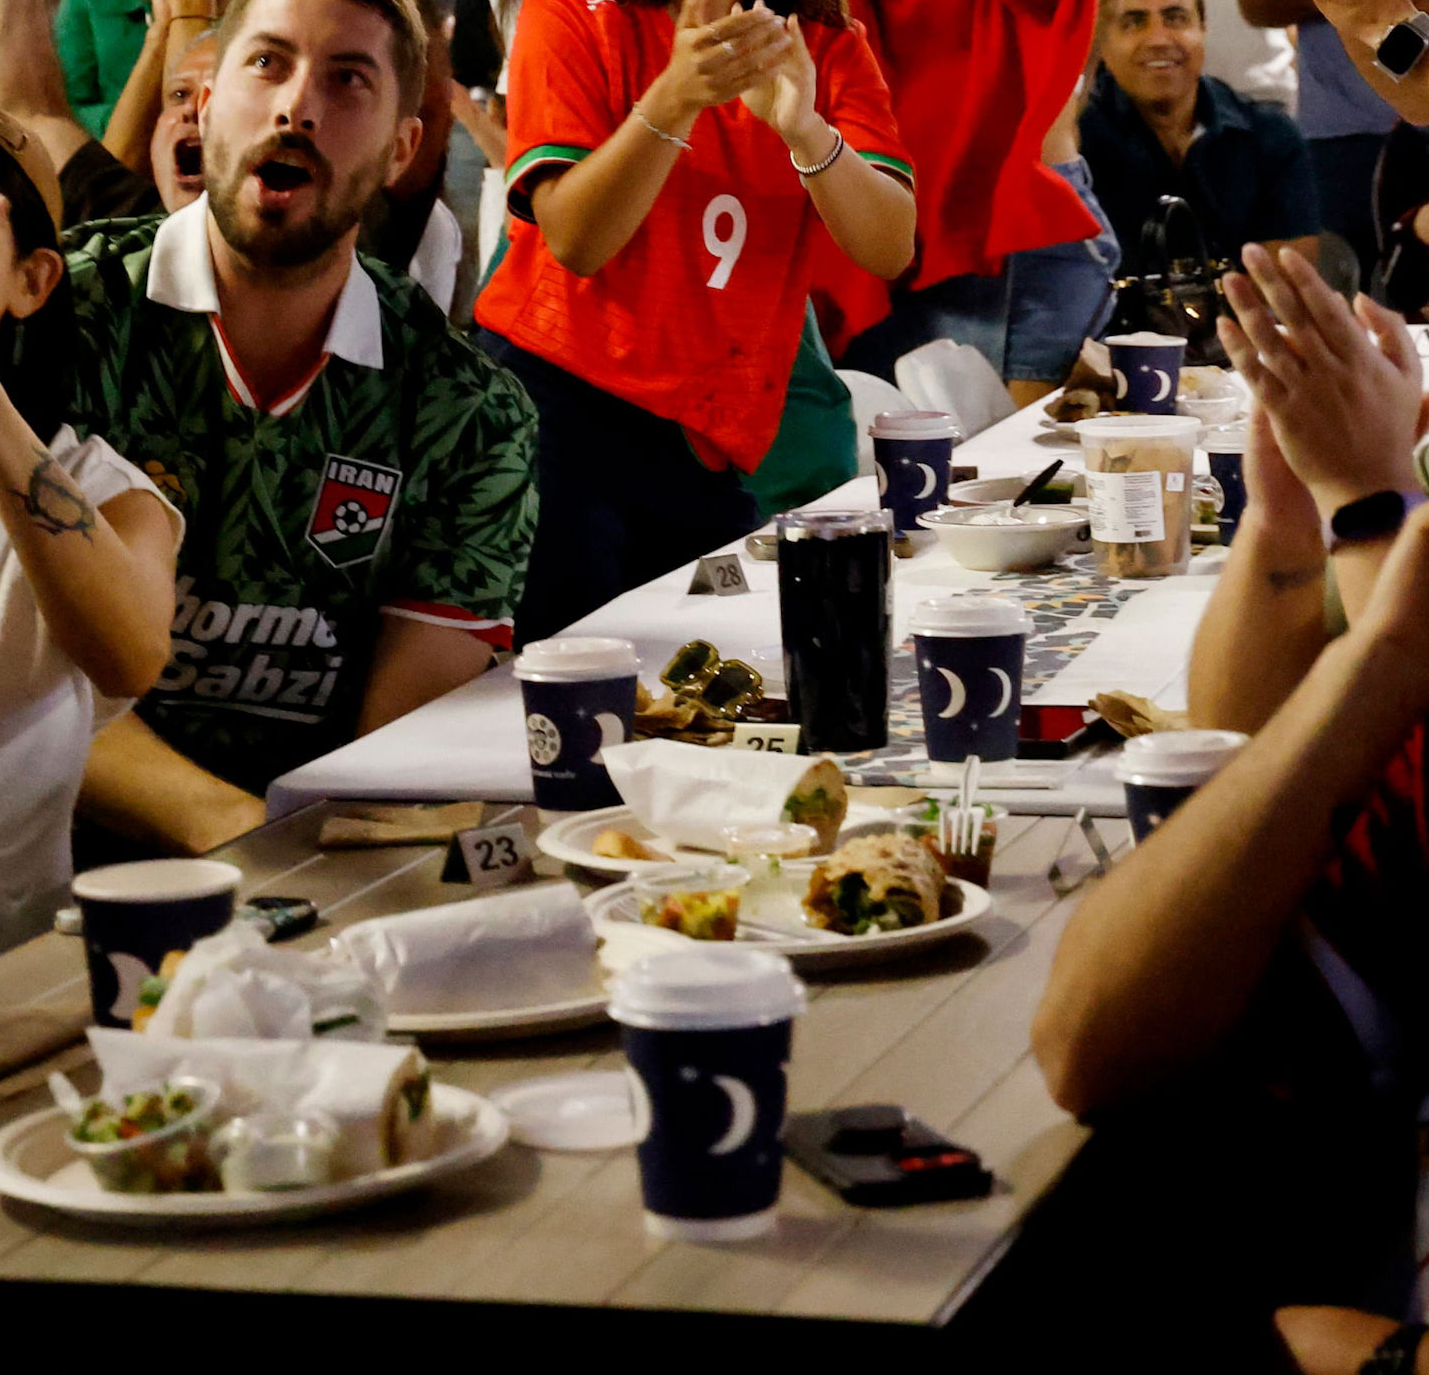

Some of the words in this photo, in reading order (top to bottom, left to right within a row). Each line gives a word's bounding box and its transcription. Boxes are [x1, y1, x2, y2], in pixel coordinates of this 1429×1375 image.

[702, 194, 747, 289] 9
[328, 461, 395, 495] IRAN
[716, 563, 741, 588] 28
[156, 639, 343, 706] Sabzi
[474, 835, 519, 871] 23
